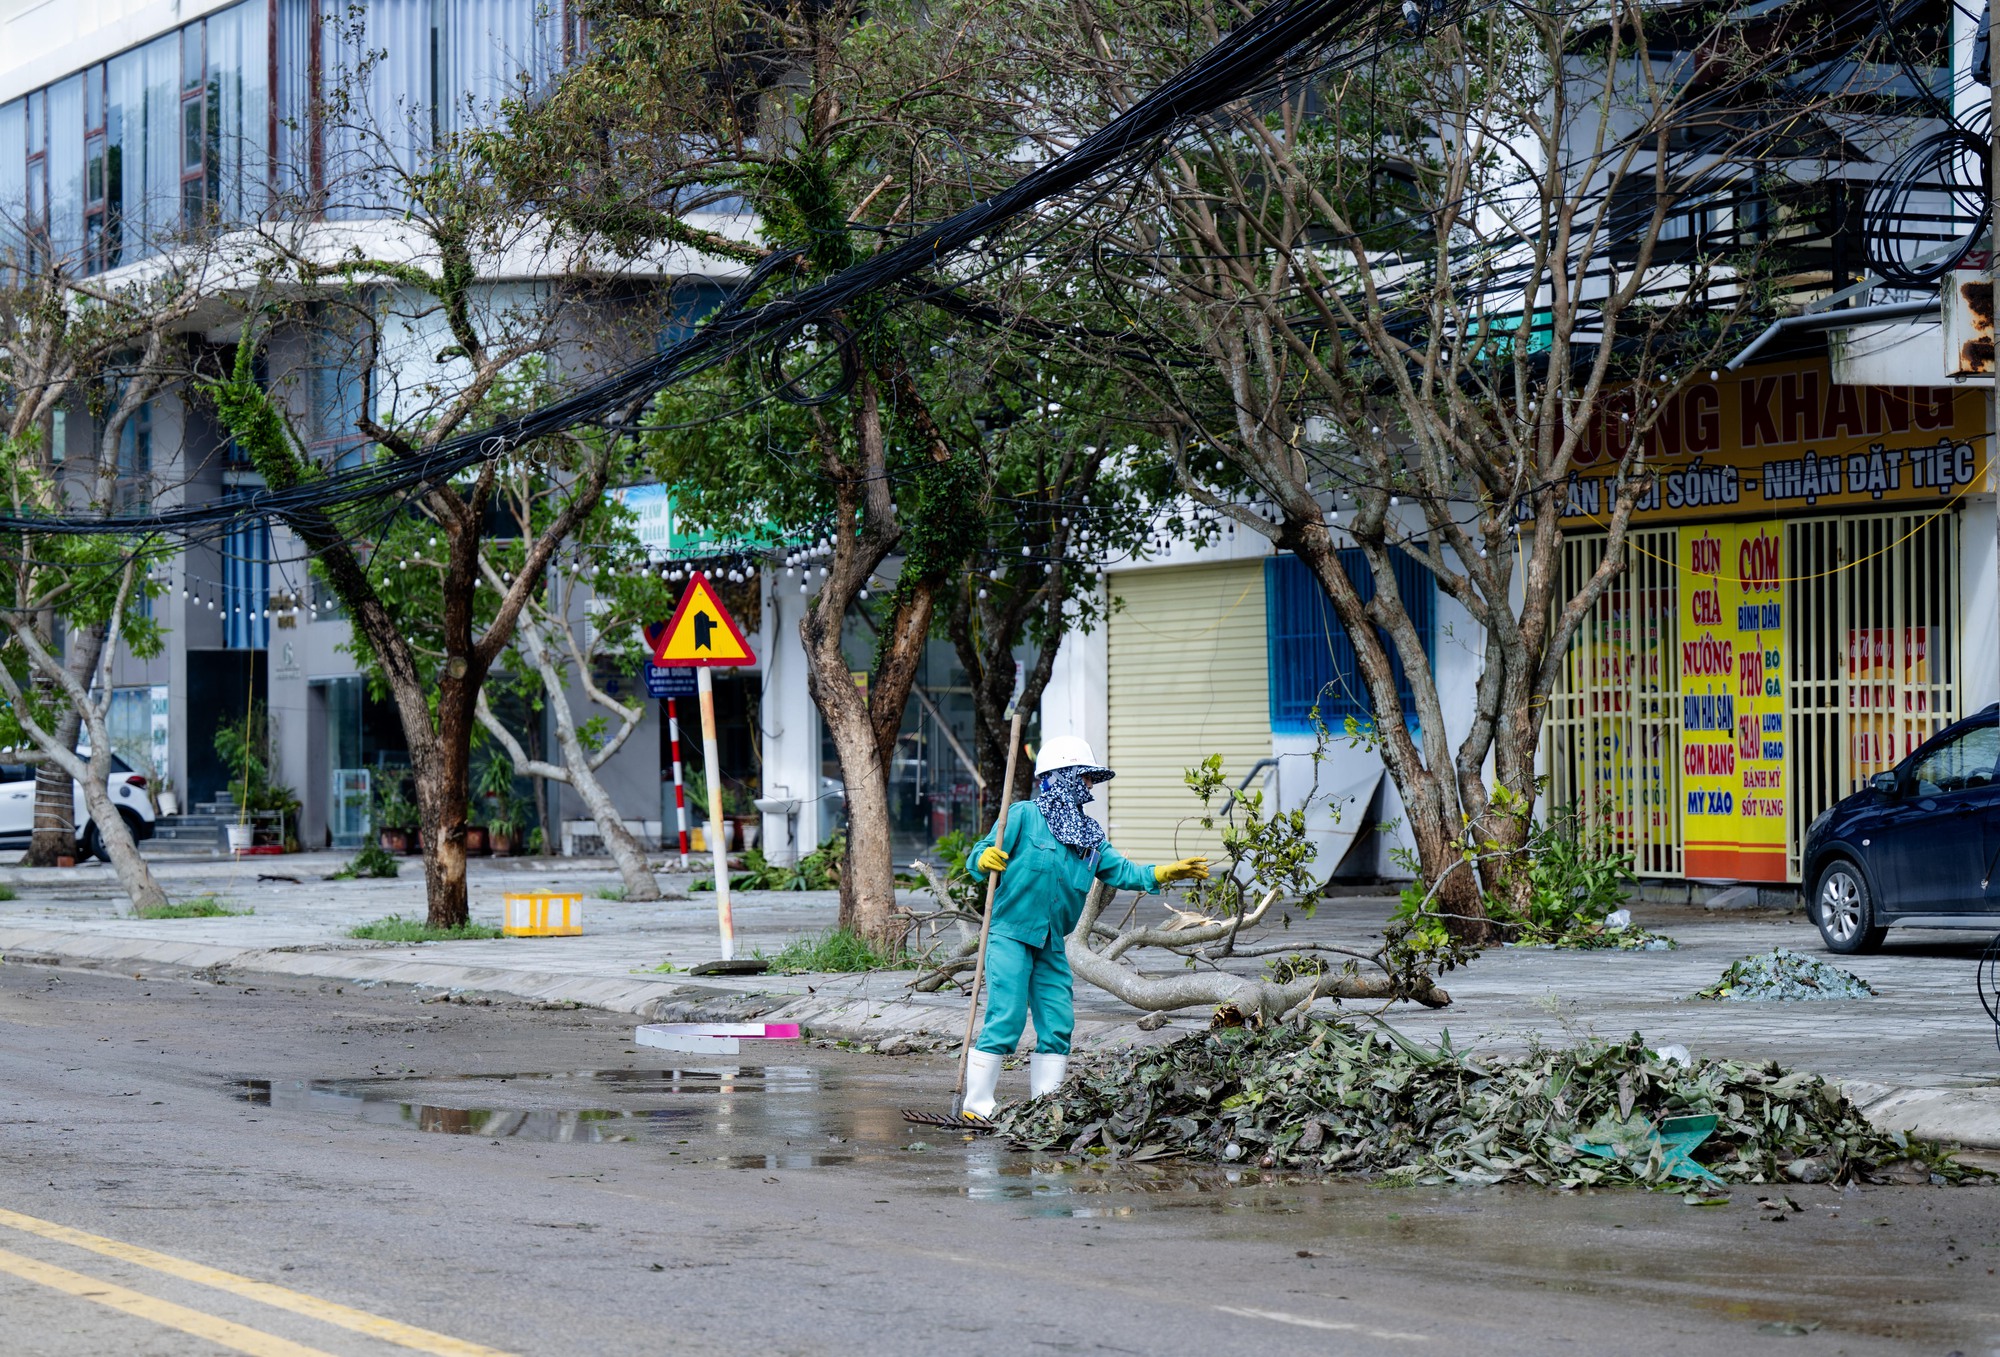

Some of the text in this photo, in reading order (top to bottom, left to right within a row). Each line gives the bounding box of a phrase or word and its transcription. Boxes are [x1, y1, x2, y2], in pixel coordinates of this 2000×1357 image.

[1740, 369, 1955, 448] KHANG
[1667, 456, 1739, 509] SỐNG
[1762, 450, 1842, 504] NHẬN
[1847, 444, 1903, 499] ĐẶT
[1909, 436, 1975, 494] TIỆC
[1691, 529, 1721, 575] BÚN
[1739, 527, 1780, 594] CƠM
[1692, 576, 1722, 625] CHẢ
[1738, 598, 1781, 632] BÌNH DÂN
[1682, 631, 1733, 676] NƯỚNG
[1739, 632, 1781, 697] PHỞ BÒ
[1684, 682, 1734, 731] BÚN HẢI SẢN
[1765, 674, 1782, 697] GÀ
[1707, 743, 1735, 776] RANG
[1762, 741, 1784, 761] NGAO
[1743, 767, 1767, 788] BÁNH
[1707, 786, 1733, 815] XÀO
[1741, 792, 1784, 817] SỐT VANG
